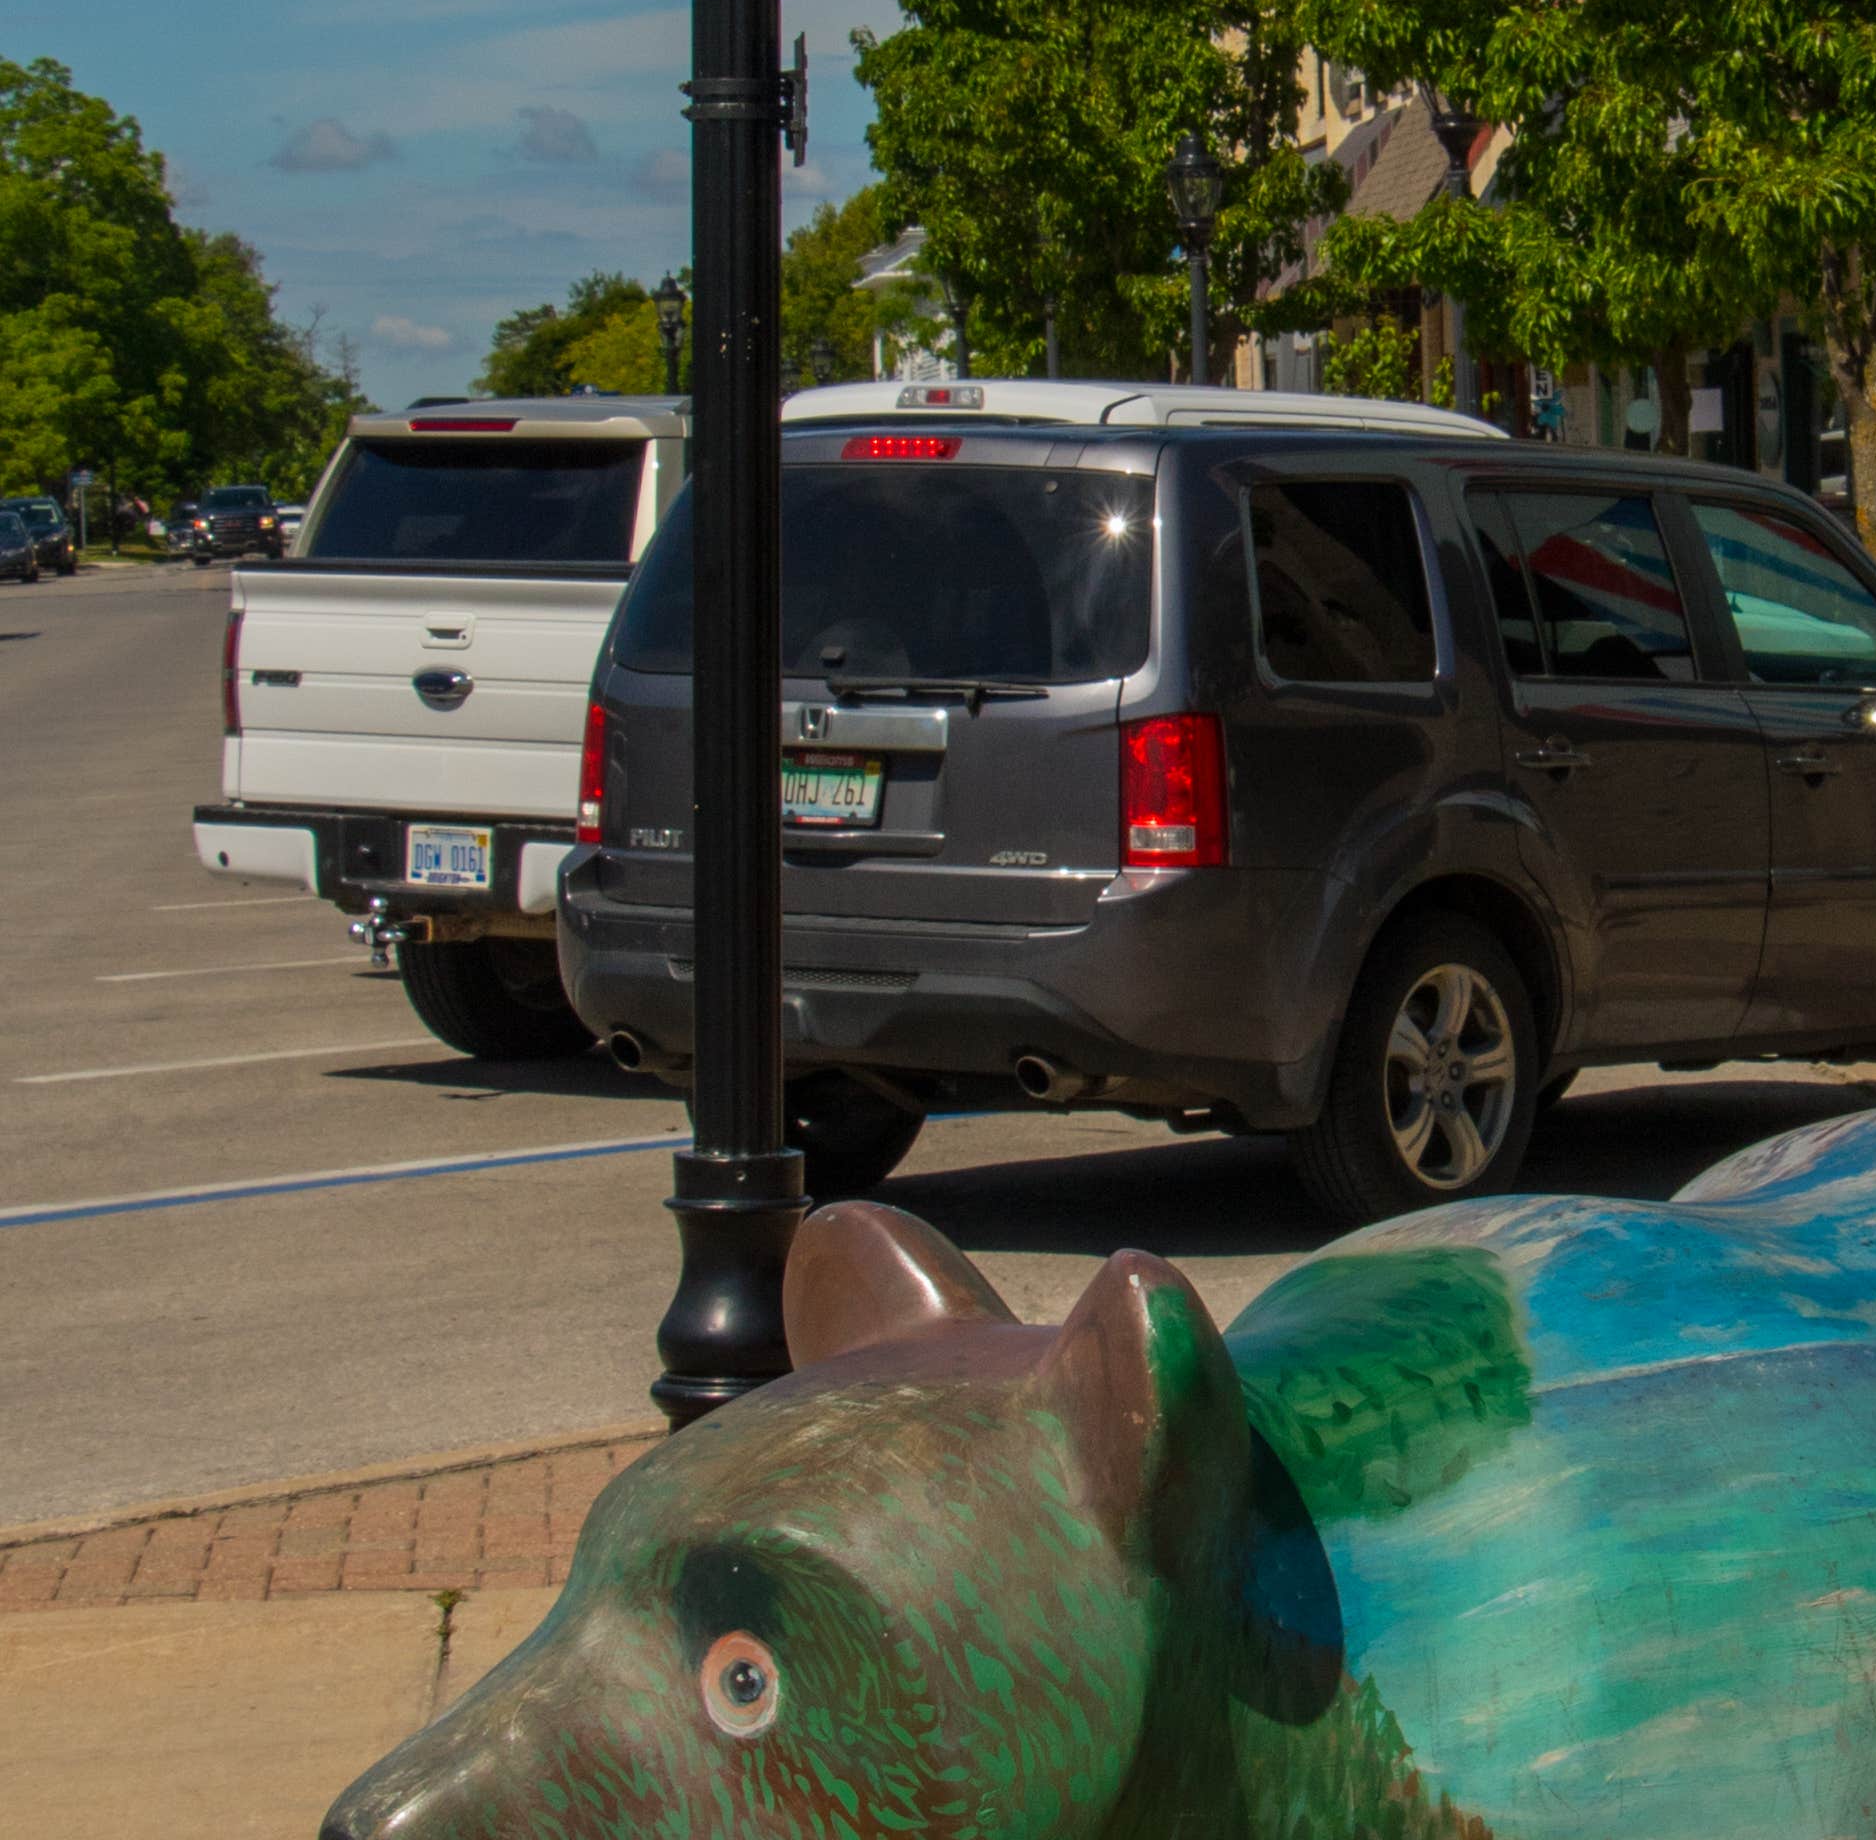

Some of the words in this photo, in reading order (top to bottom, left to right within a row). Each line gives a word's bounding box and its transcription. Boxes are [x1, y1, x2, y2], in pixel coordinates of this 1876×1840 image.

[629, 828, 684, 849] PILOT
[451, 845, 484, 872] 0161
[989, 851, 1047, 866] 4WD
